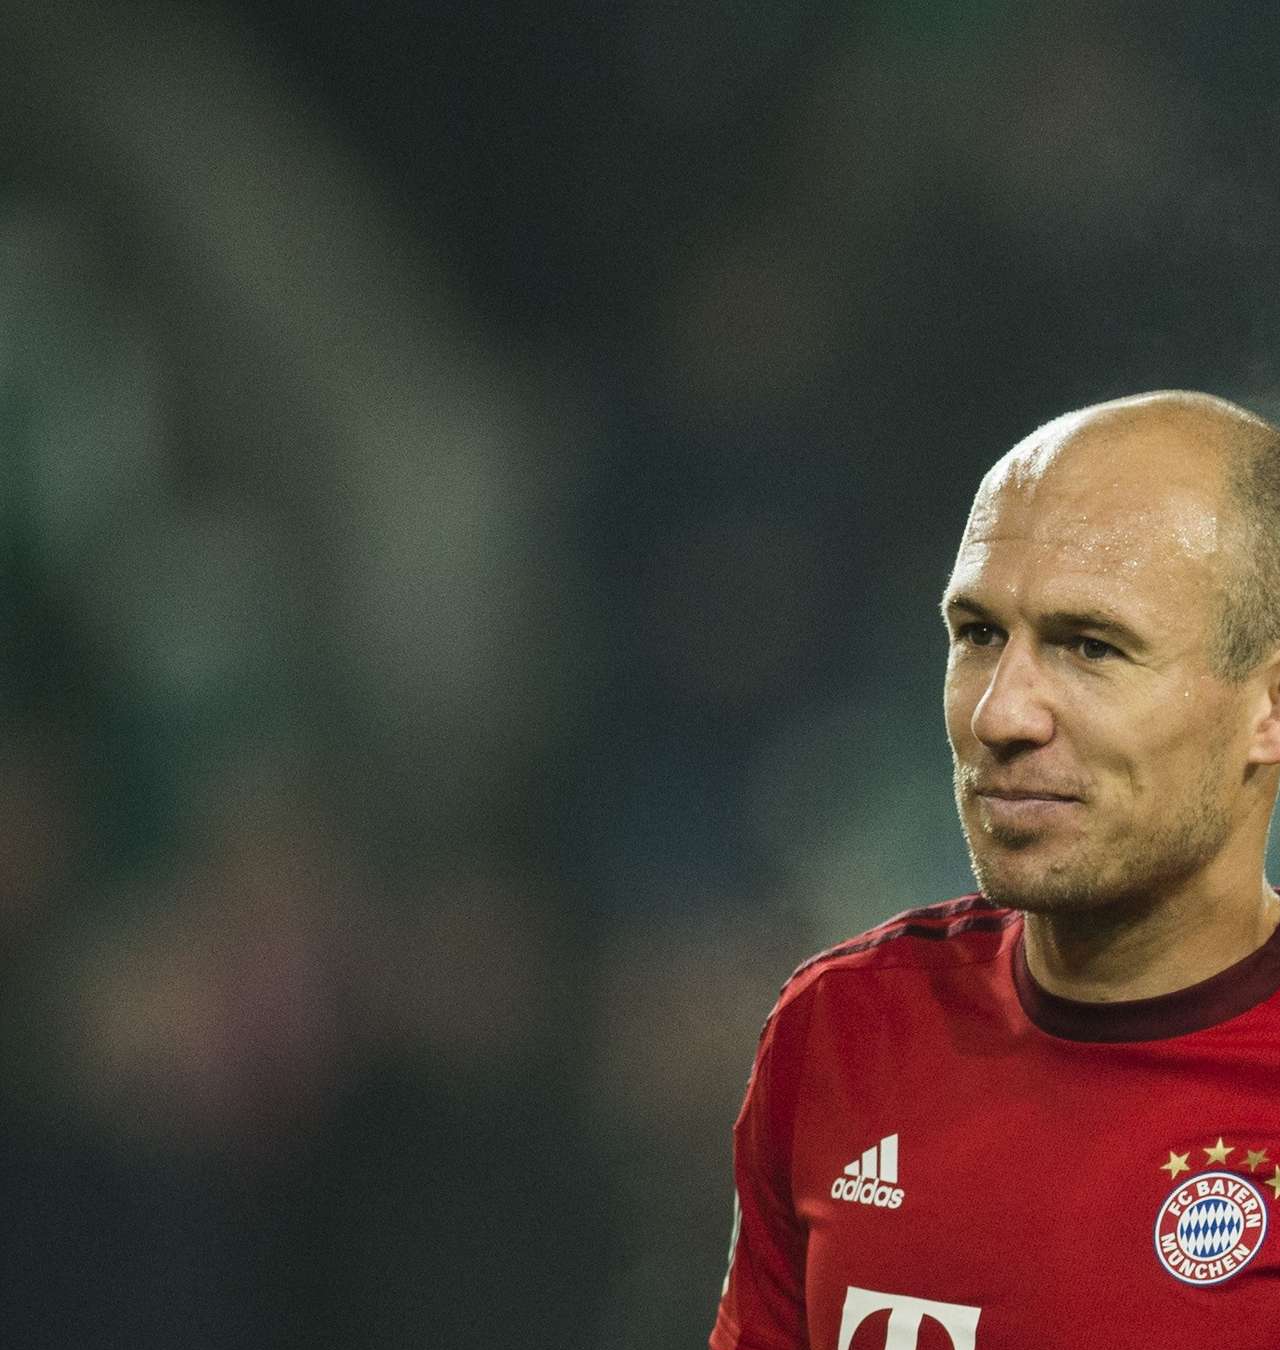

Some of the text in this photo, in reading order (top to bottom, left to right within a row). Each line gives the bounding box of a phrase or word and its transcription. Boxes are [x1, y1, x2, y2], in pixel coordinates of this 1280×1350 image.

[831, 1175, 905, 1209] adidas
[1168, 1179, 1261, 1228] FC BAYERN
